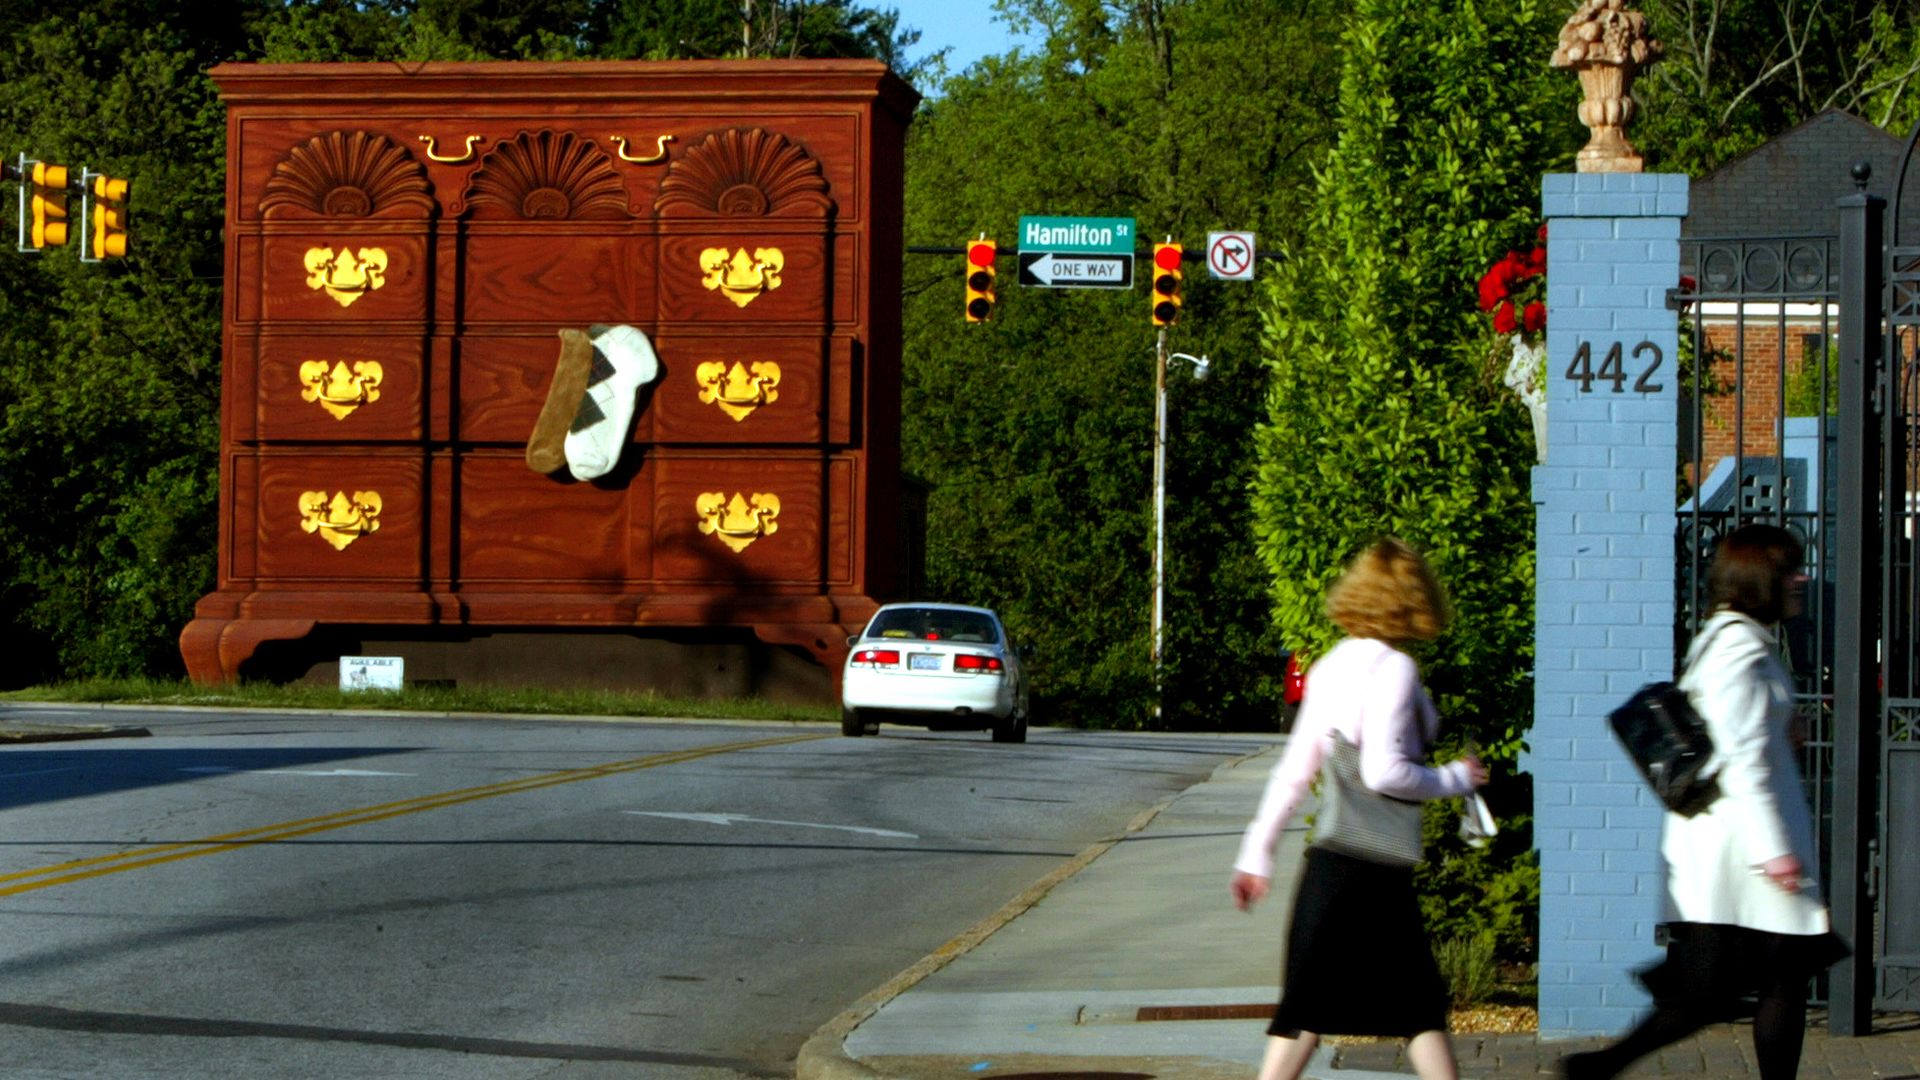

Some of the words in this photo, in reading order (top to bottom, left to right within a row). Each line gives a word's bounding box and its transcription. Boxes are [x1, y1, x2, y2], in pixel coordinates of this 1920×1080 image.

[1026, 222, 1112, 246] Hamilton
[1116, 224, 1128, 236] St
[1052, 263, 1083, 276] ONE
[1086, 263, 1116, 277] WAY
[1565, 340, 1663, 393] 442
